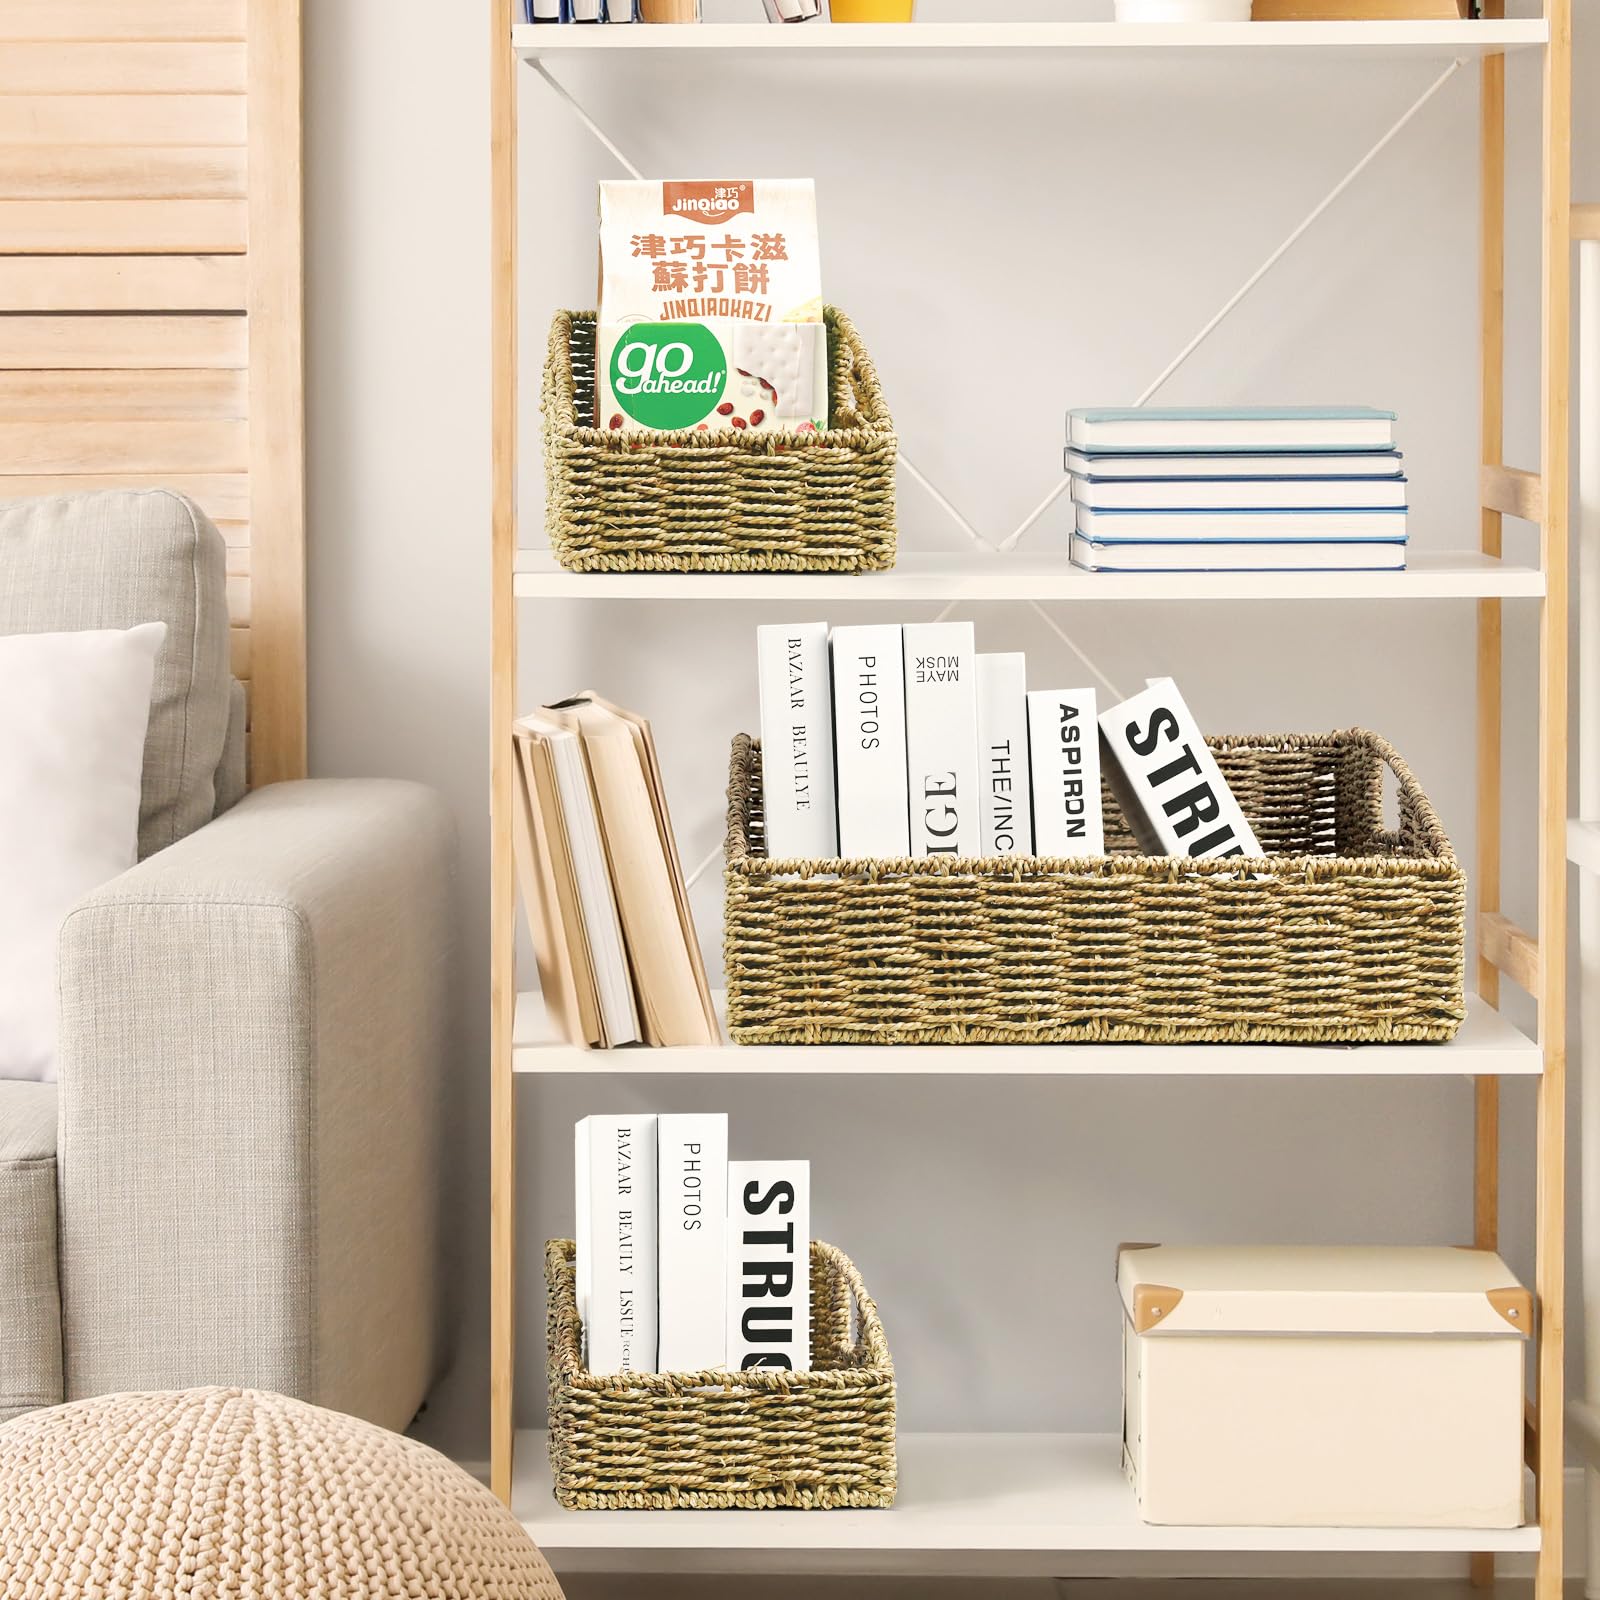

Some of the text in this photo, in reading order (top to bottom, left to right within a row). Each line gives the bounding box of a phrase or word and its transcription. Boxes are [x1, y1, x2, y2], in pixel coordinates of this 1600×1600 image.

[714, 187, 739, 199] 津巧
[629, 233, 789, 262] 津巧卡滋
[651, 260, 770, 295] 蘇打餅
[659, 297, 772, 322] JINQIAOKAZI
[615, 342, 694, 395] go
[642, 370, 722, 394] ahead!
[915, 655, 959, 669] MUSK
[915, 669, 959, 683] MAYE
[787, 637, 811, 811] BAZAAR BEAULYE
[857, 656, 880, 750] PHOTOS
[1059, 703, 1087, 838] ASPIRON
[990, 739, 1015, 858] THE/INC
[617, 1128, 632, 1195] BAZAAR
[683, 1143, 702, 1231] PHOTOS
[618, 1210, 633, 1275] BEAULY
